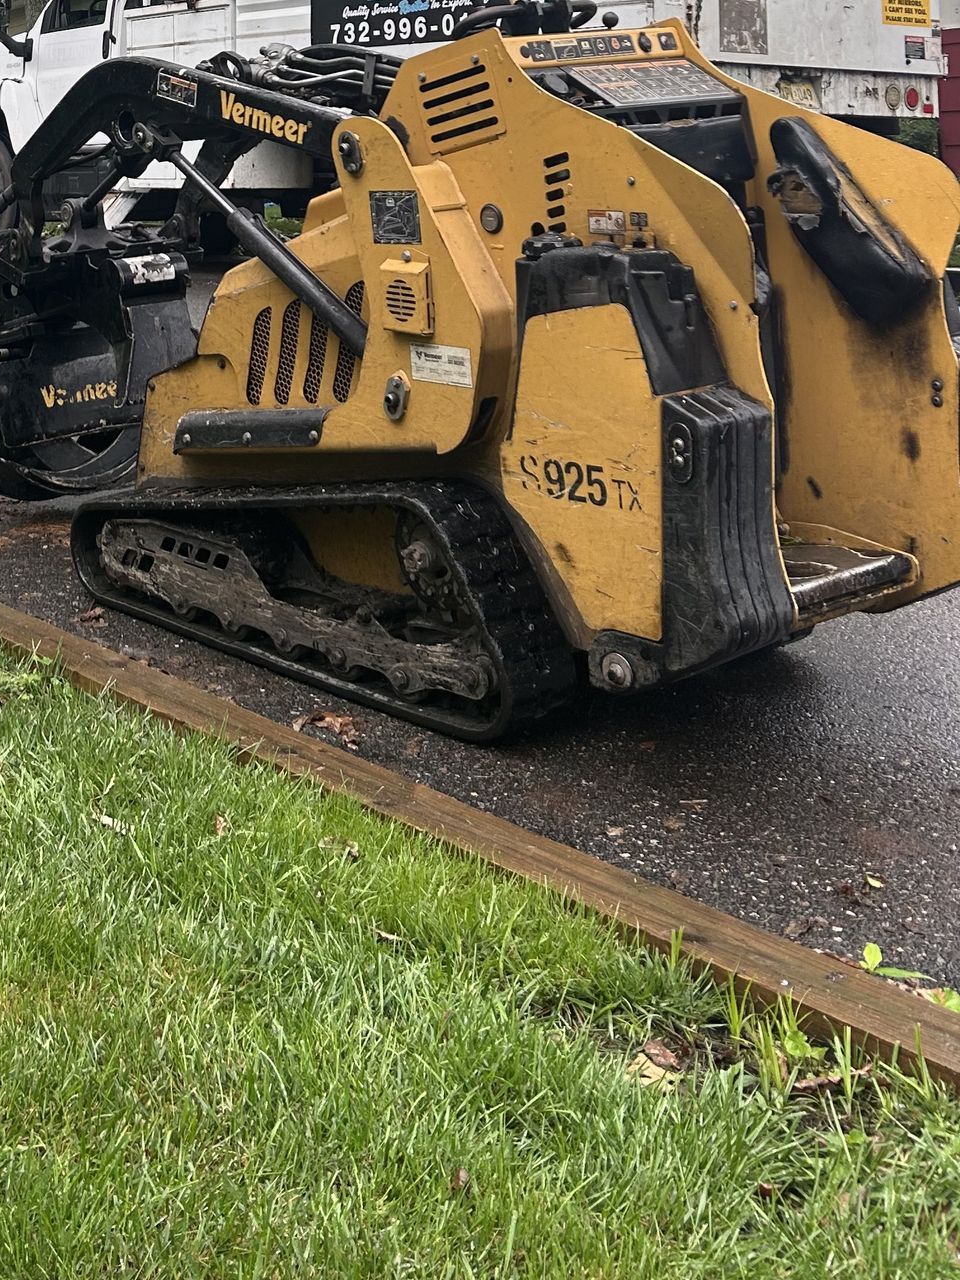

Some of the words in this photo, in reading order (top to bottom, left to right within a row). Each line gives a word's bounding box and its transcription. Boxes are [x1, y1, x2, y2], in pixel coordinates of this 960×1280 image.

[342, 4, 370, 20] Quality
[371, 2, 399, 17] Service
[888, 6, 904, 14] CAN'T
[904, 7, 913, 15] SEE
[330, 13, 502, 45] 732-996-0
[220, 89, 308, 144] Vermeer
